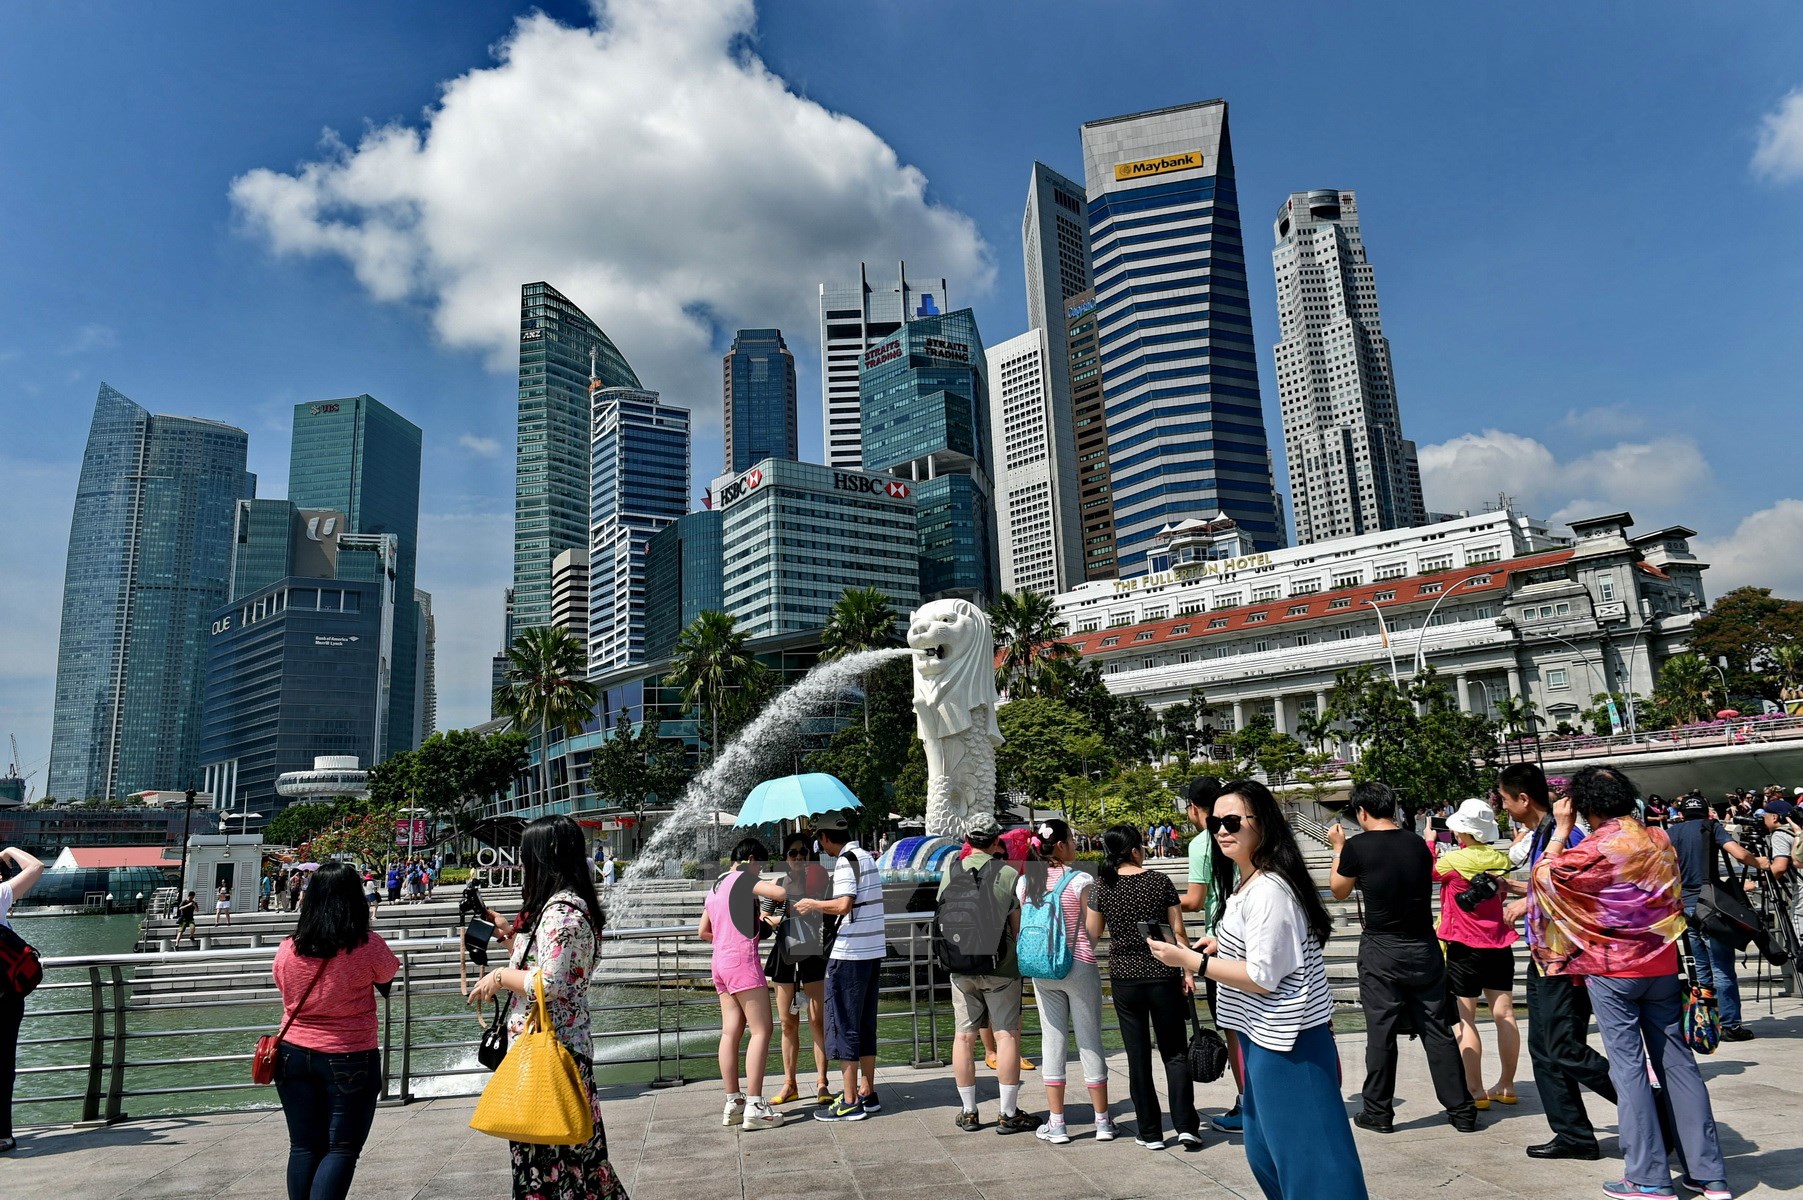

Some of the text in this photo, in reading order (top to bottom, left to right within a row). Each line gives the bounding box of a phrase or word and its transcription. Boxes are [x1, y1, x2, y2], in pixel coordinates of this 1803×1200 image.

[1133, 154, 1194, 173] Maybank
[522, 330, 542, 340] ANZ
[864, 340, 900, 361] STRAITS
[925, 347, 969, 362] TRADING
[926, 338, 968, 352] STRAITS
[865, 348, 902, 369] TRADING
[320, 404, 339, 413] UBS
[720, 477, 747, 507] HSBC
[833, 472, 883, 495] HSBC
[1113, 553, 1272, 593] THE FULLERTON HOTEL
[212, 616, 231, 635] OUE
